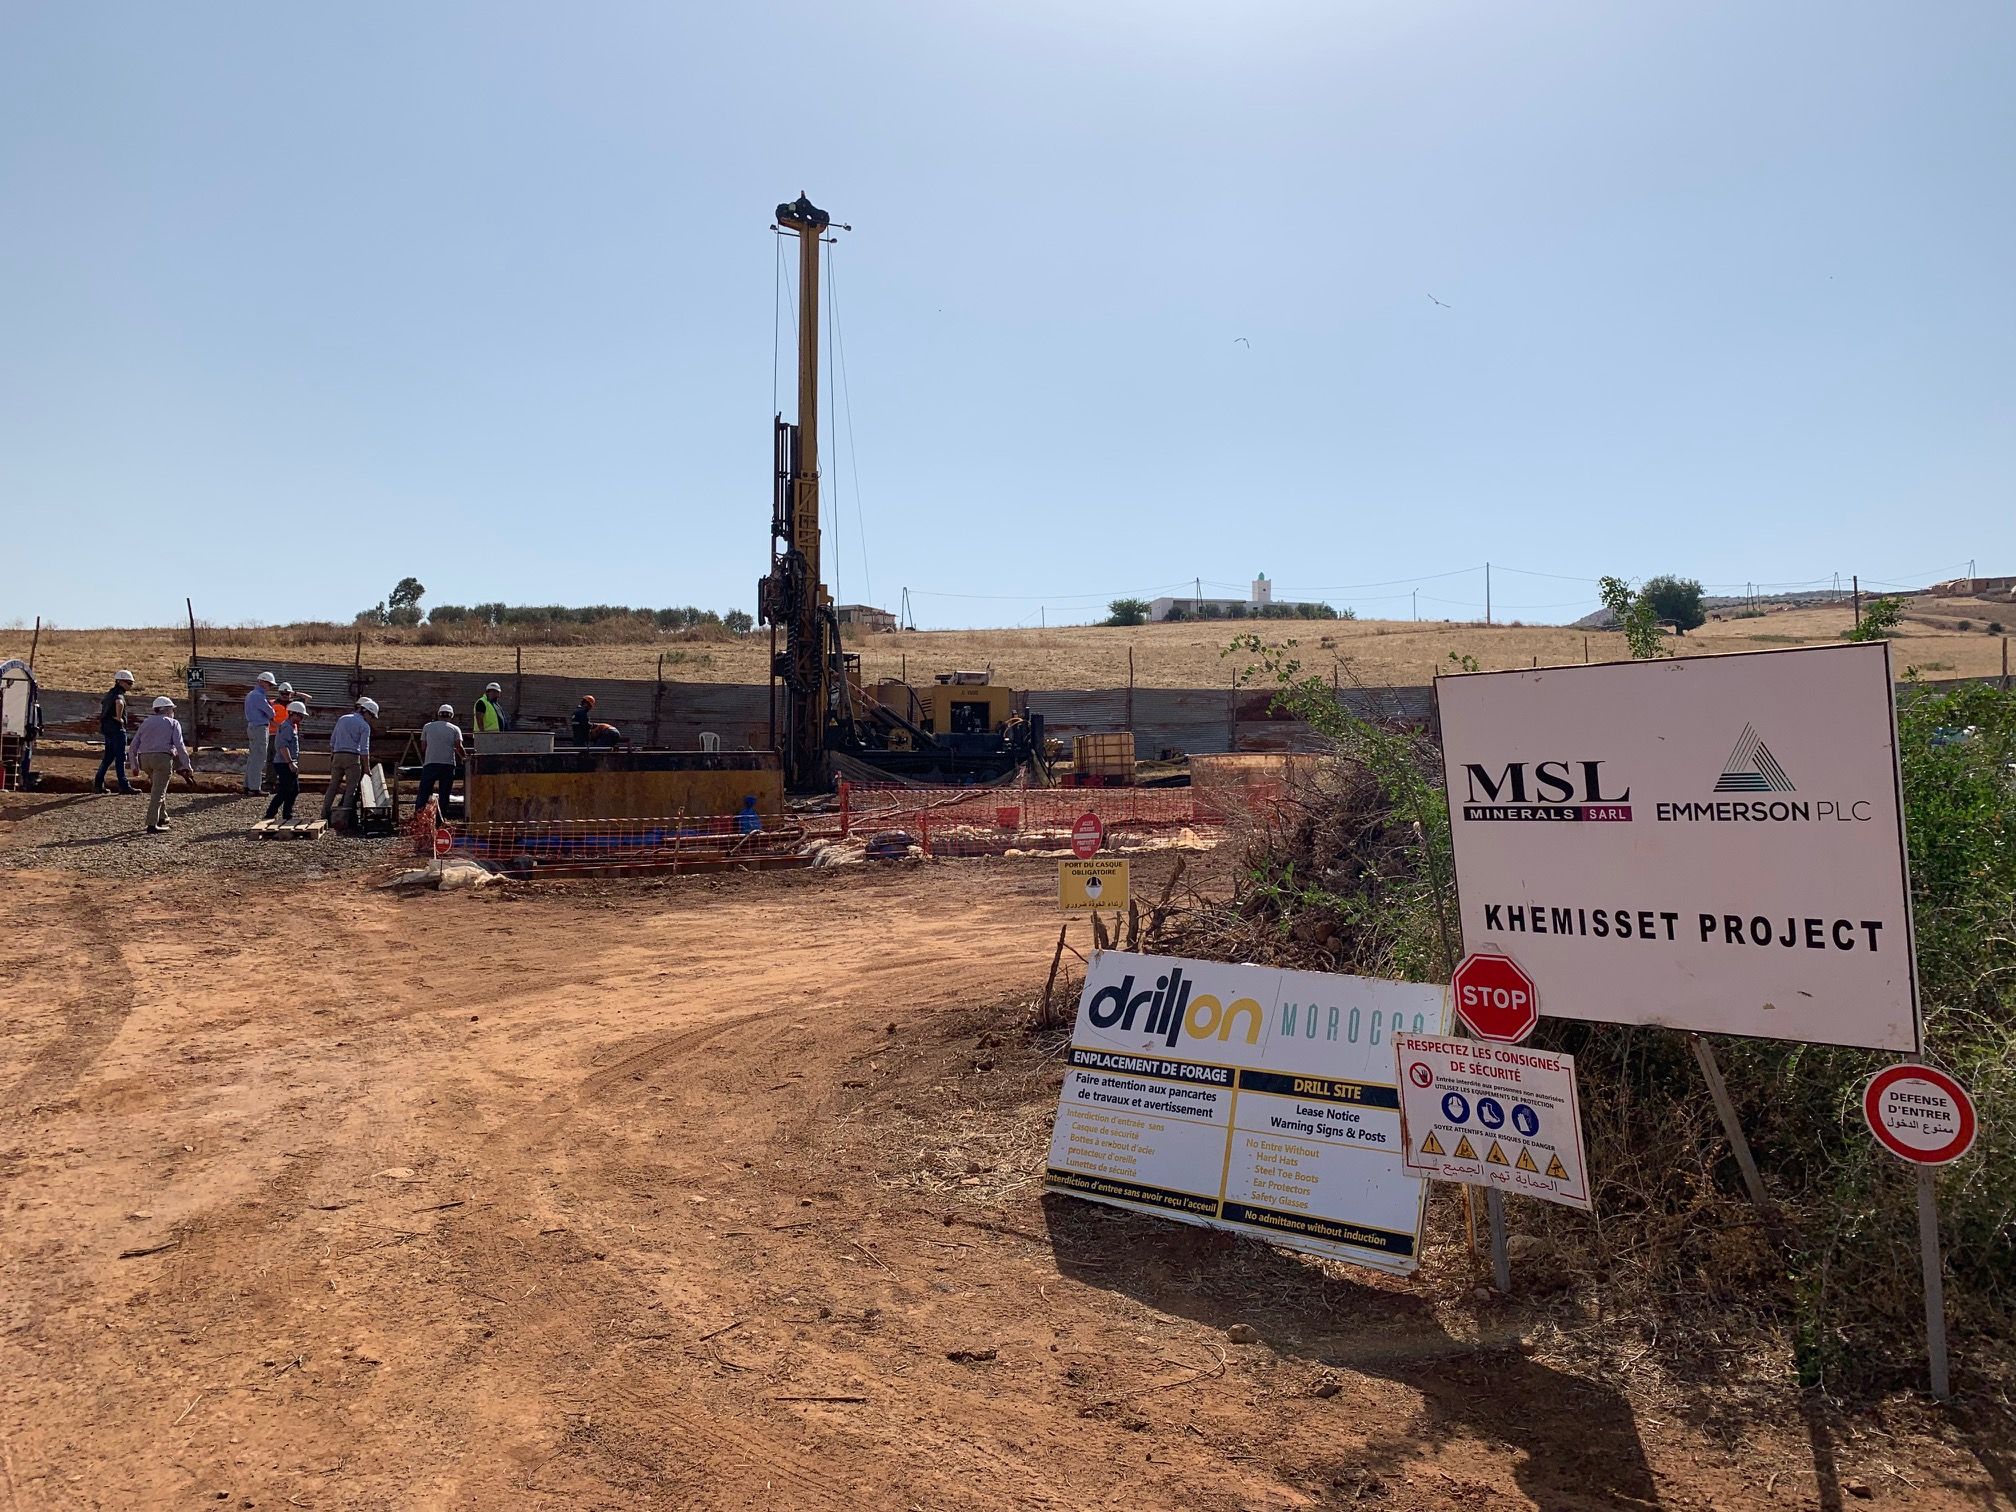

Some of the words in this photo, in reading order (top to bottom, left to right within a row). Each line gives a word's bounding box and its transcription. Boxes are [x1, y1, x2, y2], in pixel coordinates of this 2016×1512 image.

[1460, 761, 1630, 803] MSL
[1470, 808, 1575, 819] MINERALS
[1589, 809, 1626, 819] SARL
[1656, 801, 1810, 822] EMMERSON
[1817, 800, 1872, 822] PLC
[1485, 903, 1679, 940] KHEMISSET
[1699, 913, 1883, 952] PROJECT
[1089, 967, 1263, 1048] drillon
[1462, 984, 1527, 1010] STOP
[1407, 1039, 1469, 1057] RESPECTEZ
[1472, 1046, 1491, 1060] LES
[1494, 1051, 1560, 1072] CONSIGNES
[1073, 1051, 1160, 1074] ENPLACEMENT
[1161, 1064, 1177, 1076] DE
[1179, 1064, 1227, 1082] FORAGE
[1450, 1060, 1466, 1073] DE
[1469, 1062, 1522, 1082] SÉCURITÉ
[1075, 1072, 1100, 1086] Faire
[1101, 1076, 1146, 1092] attention
[1149, 1084, 1167, 1095] aux
[1168, 1087, 1217, 1102] pancartes
[1293, 1079, 1331, 1097] DRILL
[1333, 1084, 1362, 1100] SITE
[1434, 1084, 1460, 1092] UTILISEZ
[1520, 1097, 1555, 1109] PROTECTION
[1078, 1088, 1091, 1100] de
[1093, 1092, 1129, 1106] travaux
[1131, 1098, 1142, 1107] et
[1143, 1100, 1214, 1118] avertissement
[1890, 1092, 1947, 1107] DEFENSE
[1066, 1109, 1111, 1123] Interdiction
[1148, 1123, 1165, 1132] sans
[1296, 1104, 1324, 1118] Lease
[1326, 1108, 1360, 1123] Notice
[1886, 1116, 1919, 1129] الدخول
[1888, 1104, 1951, 1121] D'ENTRER
[1072, 1122, 1099, 1134] Casque
[1100, 1126, 1110, 1135] de
[1270, 1116, 1314, 1135] Warning
[1316, 1123, 1344, 1137] Signs
[1346, 1127, 1356, 1139] &
[1358, 1129, 1386, 1143] Posts
[1433, 1123, 1453, 1132] SOYEZ
[1454, 1126, 1484, 1136] ATTENTIFS
[1498, 1133, 1522, 1144] RISQUES
[1531, 1141, 1556, 1152] DANGER
[1922, 1122, 1954, 1134] ممنوع
[1070, 1133, 1094, 1144] Bottes
[1094, 1137, 1100, 1146] à
[1246, 1138, 1259, 1148] No
[1284, 1144, 1319, 1158] Without
[1067, 1146, 1107, 1160] protecteur
[1107, 1151, 1137, 1165] d'oreille
[1256, 1151, 1277, 1162] Hard
[1279, 1156, 1298, 1166] Hats
[1066, 1157, 1097, 1169] Lunettes
[1098, 1161, 1108, 1171] de
[1109, 1164, 1137, 1177] sécurité
[1254, 1165, 1275, 1176] Steel
[1277, 1168, 1293, 1179] Toe
[1295, 1171, 1319, 1183] Boots
[1442, 1163, 1485, 1177] الجميع
[1489, 1171, 1510, 1184] تهم
[1253, 1178, 1266, 1187] Ear
[1268, 1180, 1311, 1195] Protectors
[1515, 1171, 1558, 1192] الحماية
[1123, 1187, 1141, 1198] sans
[1141, 1190, 1163, 1202] avoir
[1164, 1196, 1182, 1207] reçu
[1182, 1197, 1217, 1213] l'acceuil
[1250, 1190, 1277, 1205] Safety
[1279, 1196, 1309, 1209] Glasses
[1244, 1209, 1257, 1220] No
[1258, 1212, 1306, 1230] admittance
[1307, 1223, 1344, 1238] without
[1344, 1229, 1387, 1246] induction
